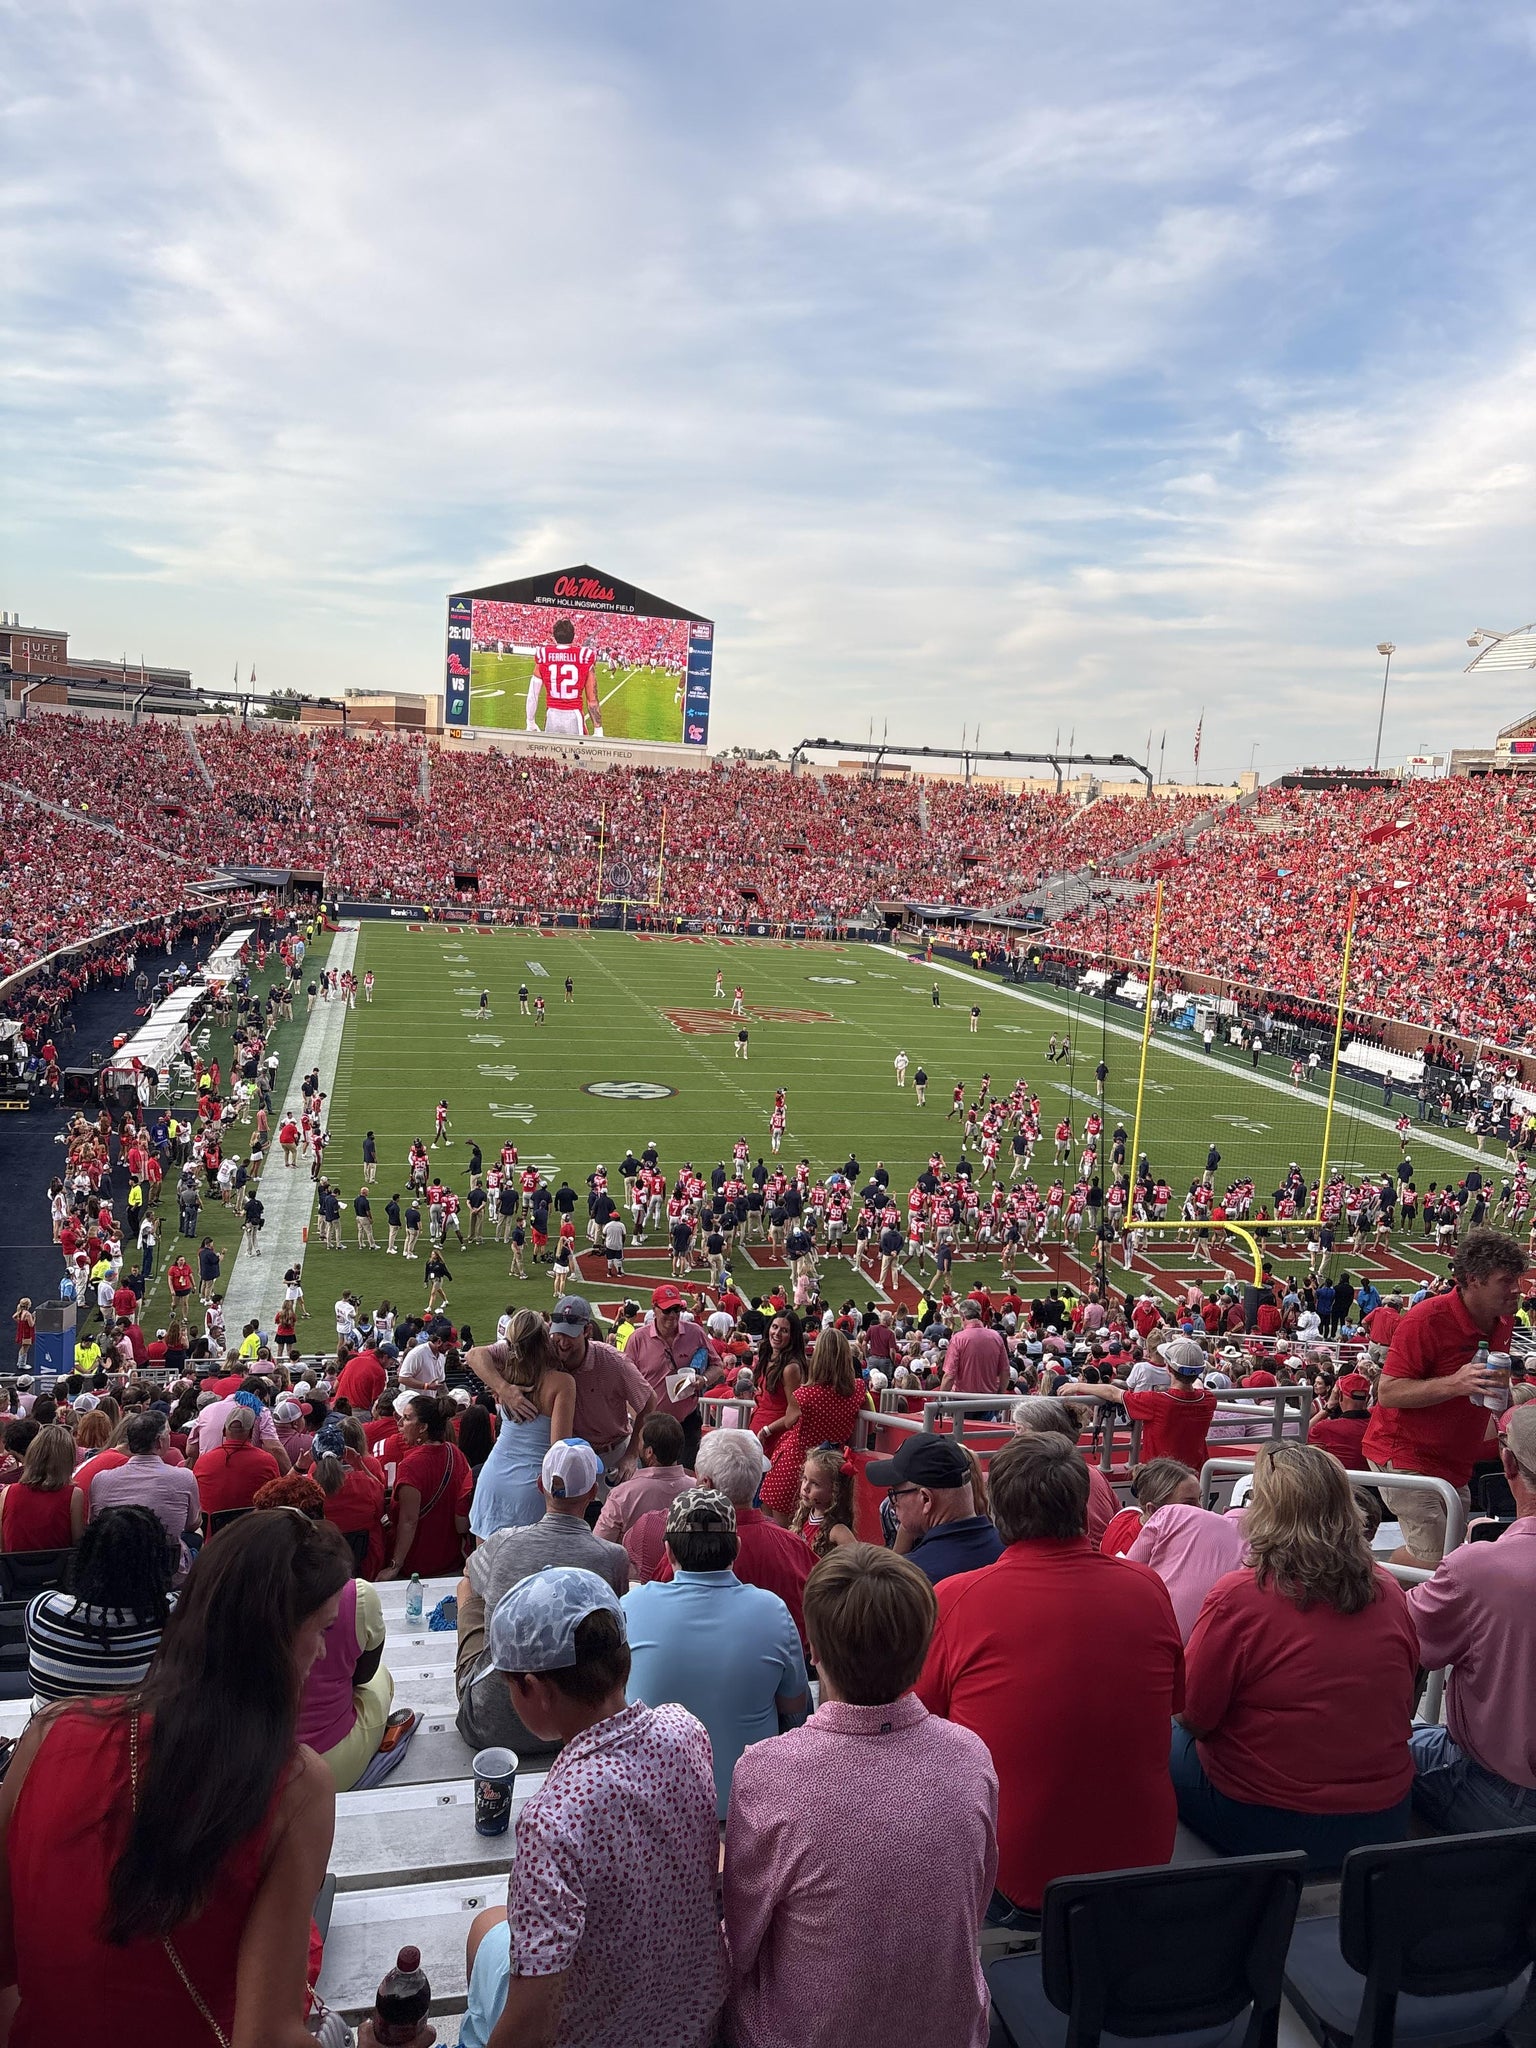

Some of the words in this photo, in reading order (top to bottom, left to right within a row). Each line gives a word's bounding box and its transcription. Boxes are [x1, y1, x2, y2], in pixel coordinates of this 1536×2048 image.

[554, 576, 579, 597] Ole
[579, 578, 616, 600] Miss
[534, 596, 556, 605] JERRY
[557, 598, 615, 611] HOLLINGSWORTH
[615, 605, 635, 613] FIELD
[448, 625, 471, 640] 25:10
[22, 641, 58, 654] DUFF
[548, 652, 577, 662] FERRELLI
[452, 677, 465, 691] VS
[548, 664, 579, 700] 12
[450, 729, 461, 739] 40
[526, 744, 549, 752] JERRY
[550, 745, 612, 758] HOLLINGSWORTH
[613, 751, 633, 760] FIELD
[390, 909, 418, 917] BankPlus
[720, 924, 744, 934] Aflc
[506, 1153, 513, 1162] 11
[523, 1177, 534, 1188] 75
[690, 1185, 700, 1195] 55
[1050, 1192, 1061, 1201] 87
[830, 1209, 842, 1219] 99
[442, 1796, 451, 1805] 9
[467, 1898, 478, 1909] 9
